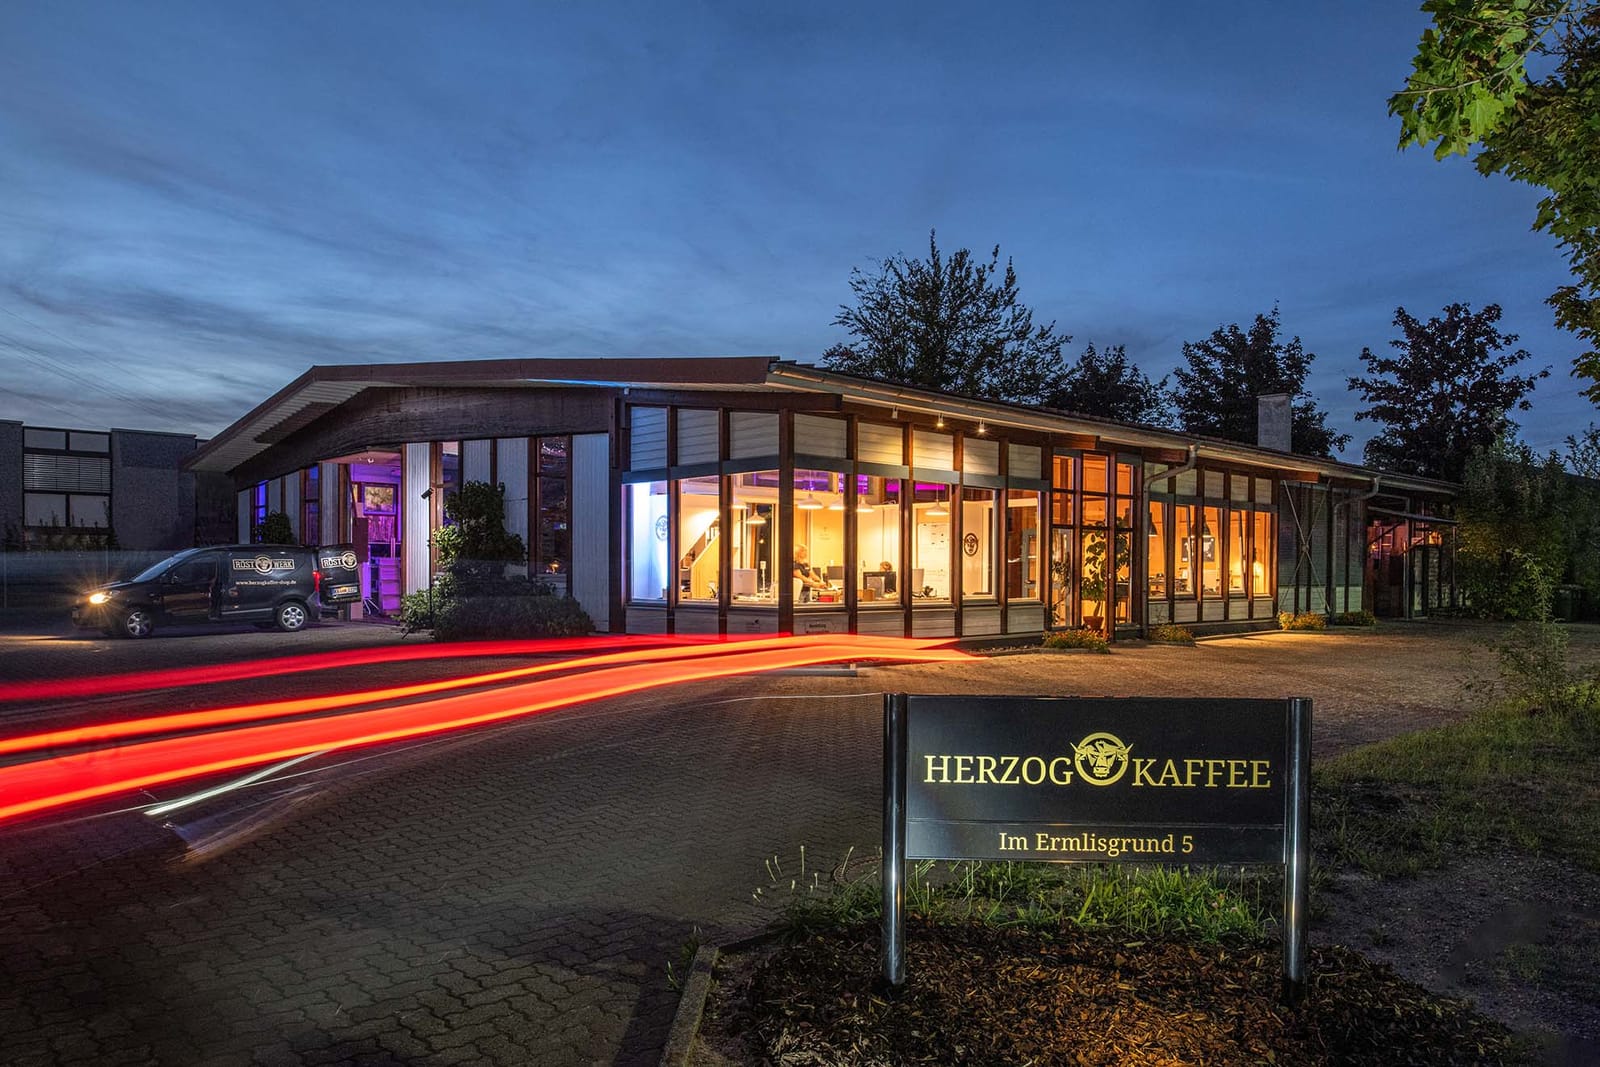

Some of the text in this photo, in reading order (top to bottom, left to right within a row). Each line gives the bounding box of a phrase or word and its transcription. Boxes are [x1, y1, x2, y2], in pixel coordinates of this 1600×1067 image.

[275, 560, 292, 568] WERK
[924, 755, 1270, 788] HERZOG KAFFEE
[999, 833, 1194, 857] Im Ermlisgrund 5
